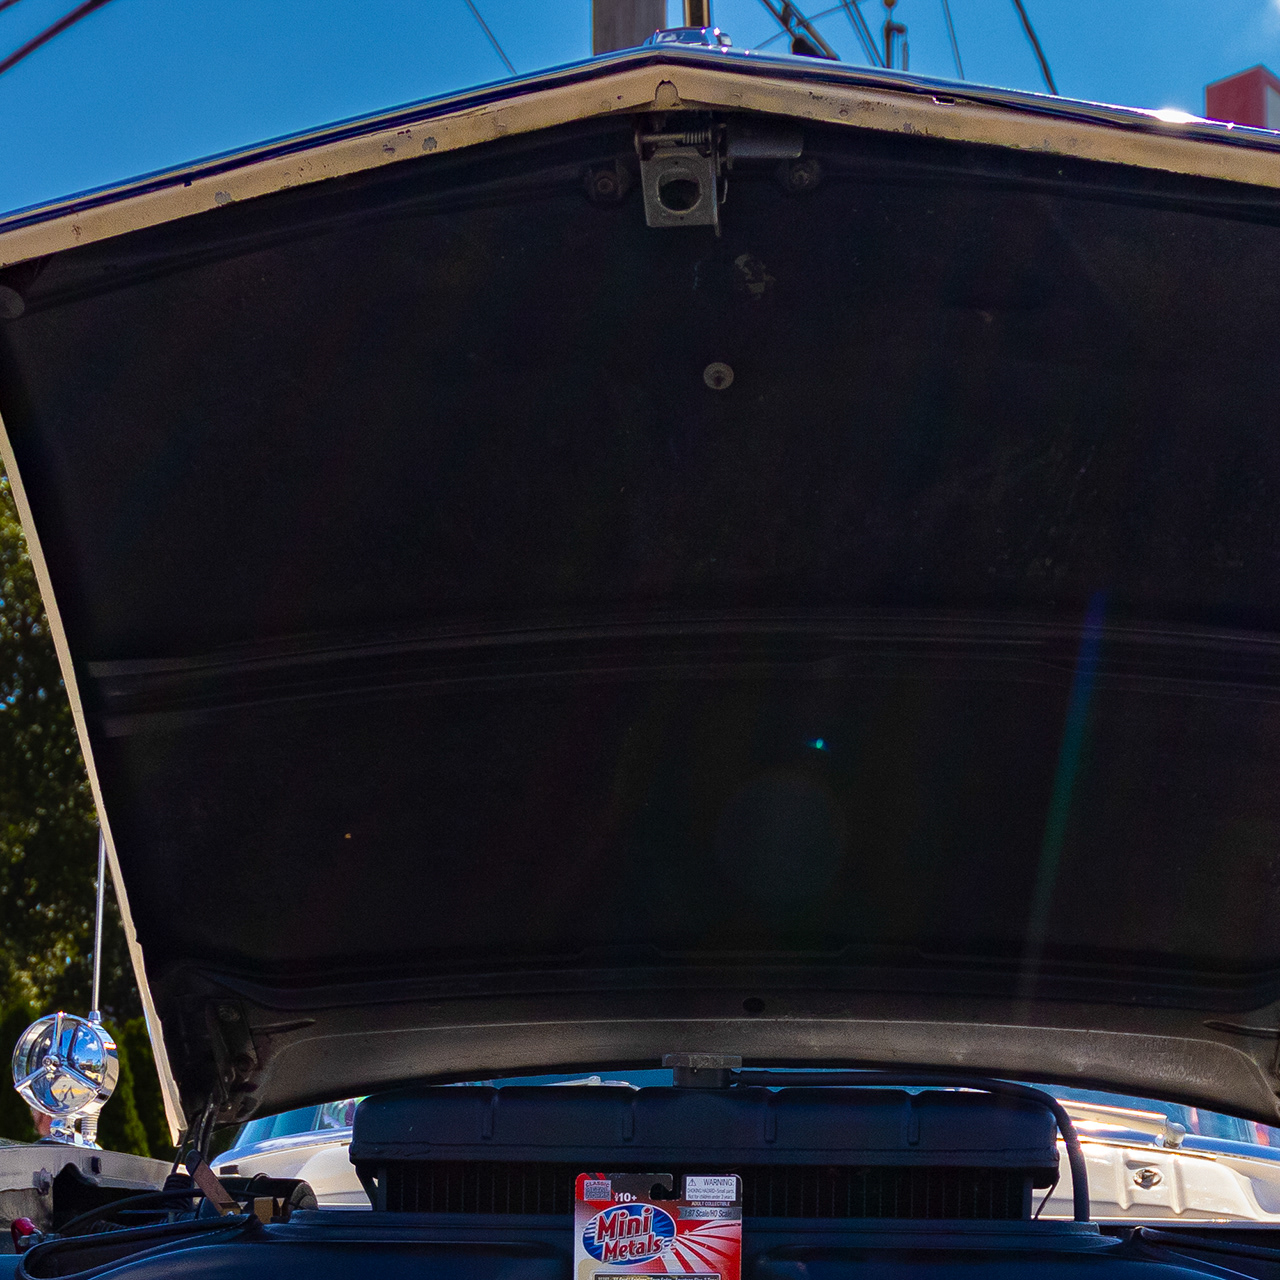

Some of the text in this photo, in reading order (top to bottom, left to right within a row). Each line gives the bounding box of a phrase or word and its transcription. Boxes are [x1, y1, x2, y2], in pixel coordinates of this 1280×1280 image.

[703, 1178, 734, 1187] WARNING:
[619, 1192, 637, 1202] 10+
[596, 1207, 652, 1243] Mini
[603, 1234, 663, 1262] Metals
